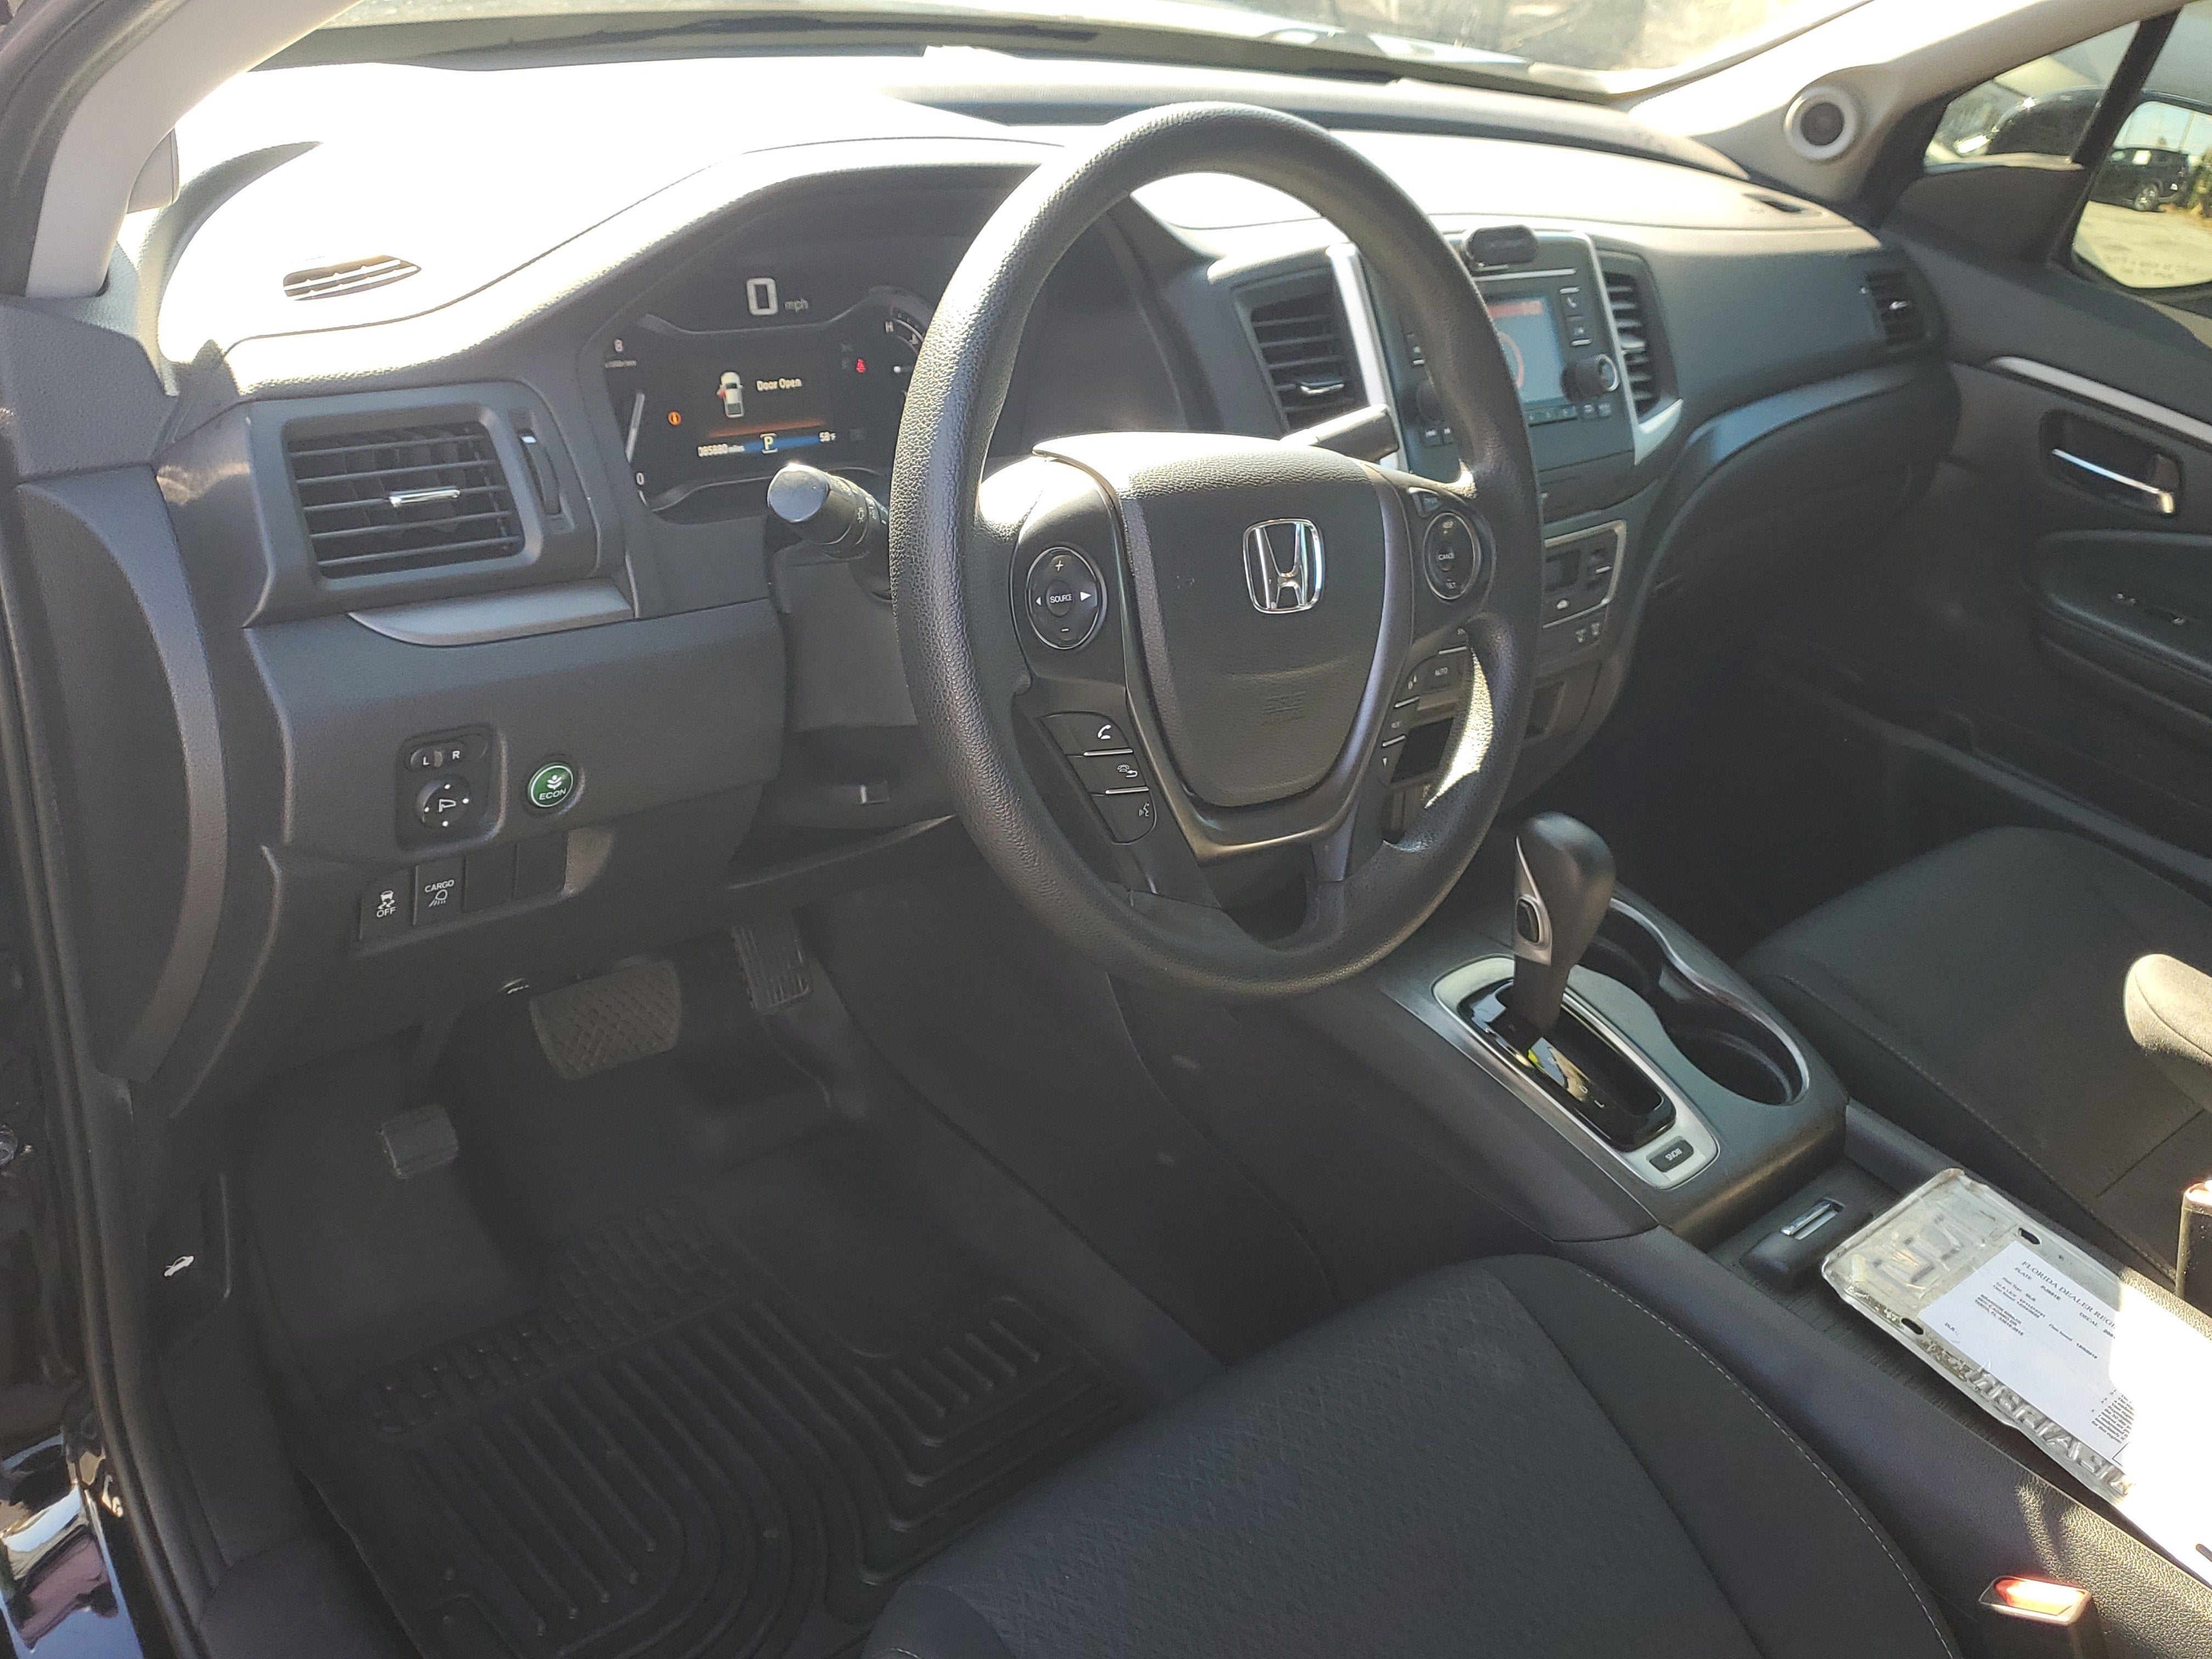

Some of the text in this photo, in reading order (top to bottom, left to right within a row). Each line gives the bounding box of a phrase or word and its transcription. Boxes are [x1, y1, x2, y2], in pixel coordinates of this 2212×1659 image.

[747, 278, 778, 316] 0
[757, 377, 802, 392] Door Open
[764, 437, 774, 450] P
[1050, 594, 1072, 603] SOURCE
[423, 750, 460, 766] L R
[539, 788, 567, 800] ECON
[425, 879, 455, 893] CARGO
[376, 906, 396, 918] OFF
[2022, 1261, 2057, 1288] FLORIDA
[2059, 1286, 2094, 1313] DEALER
